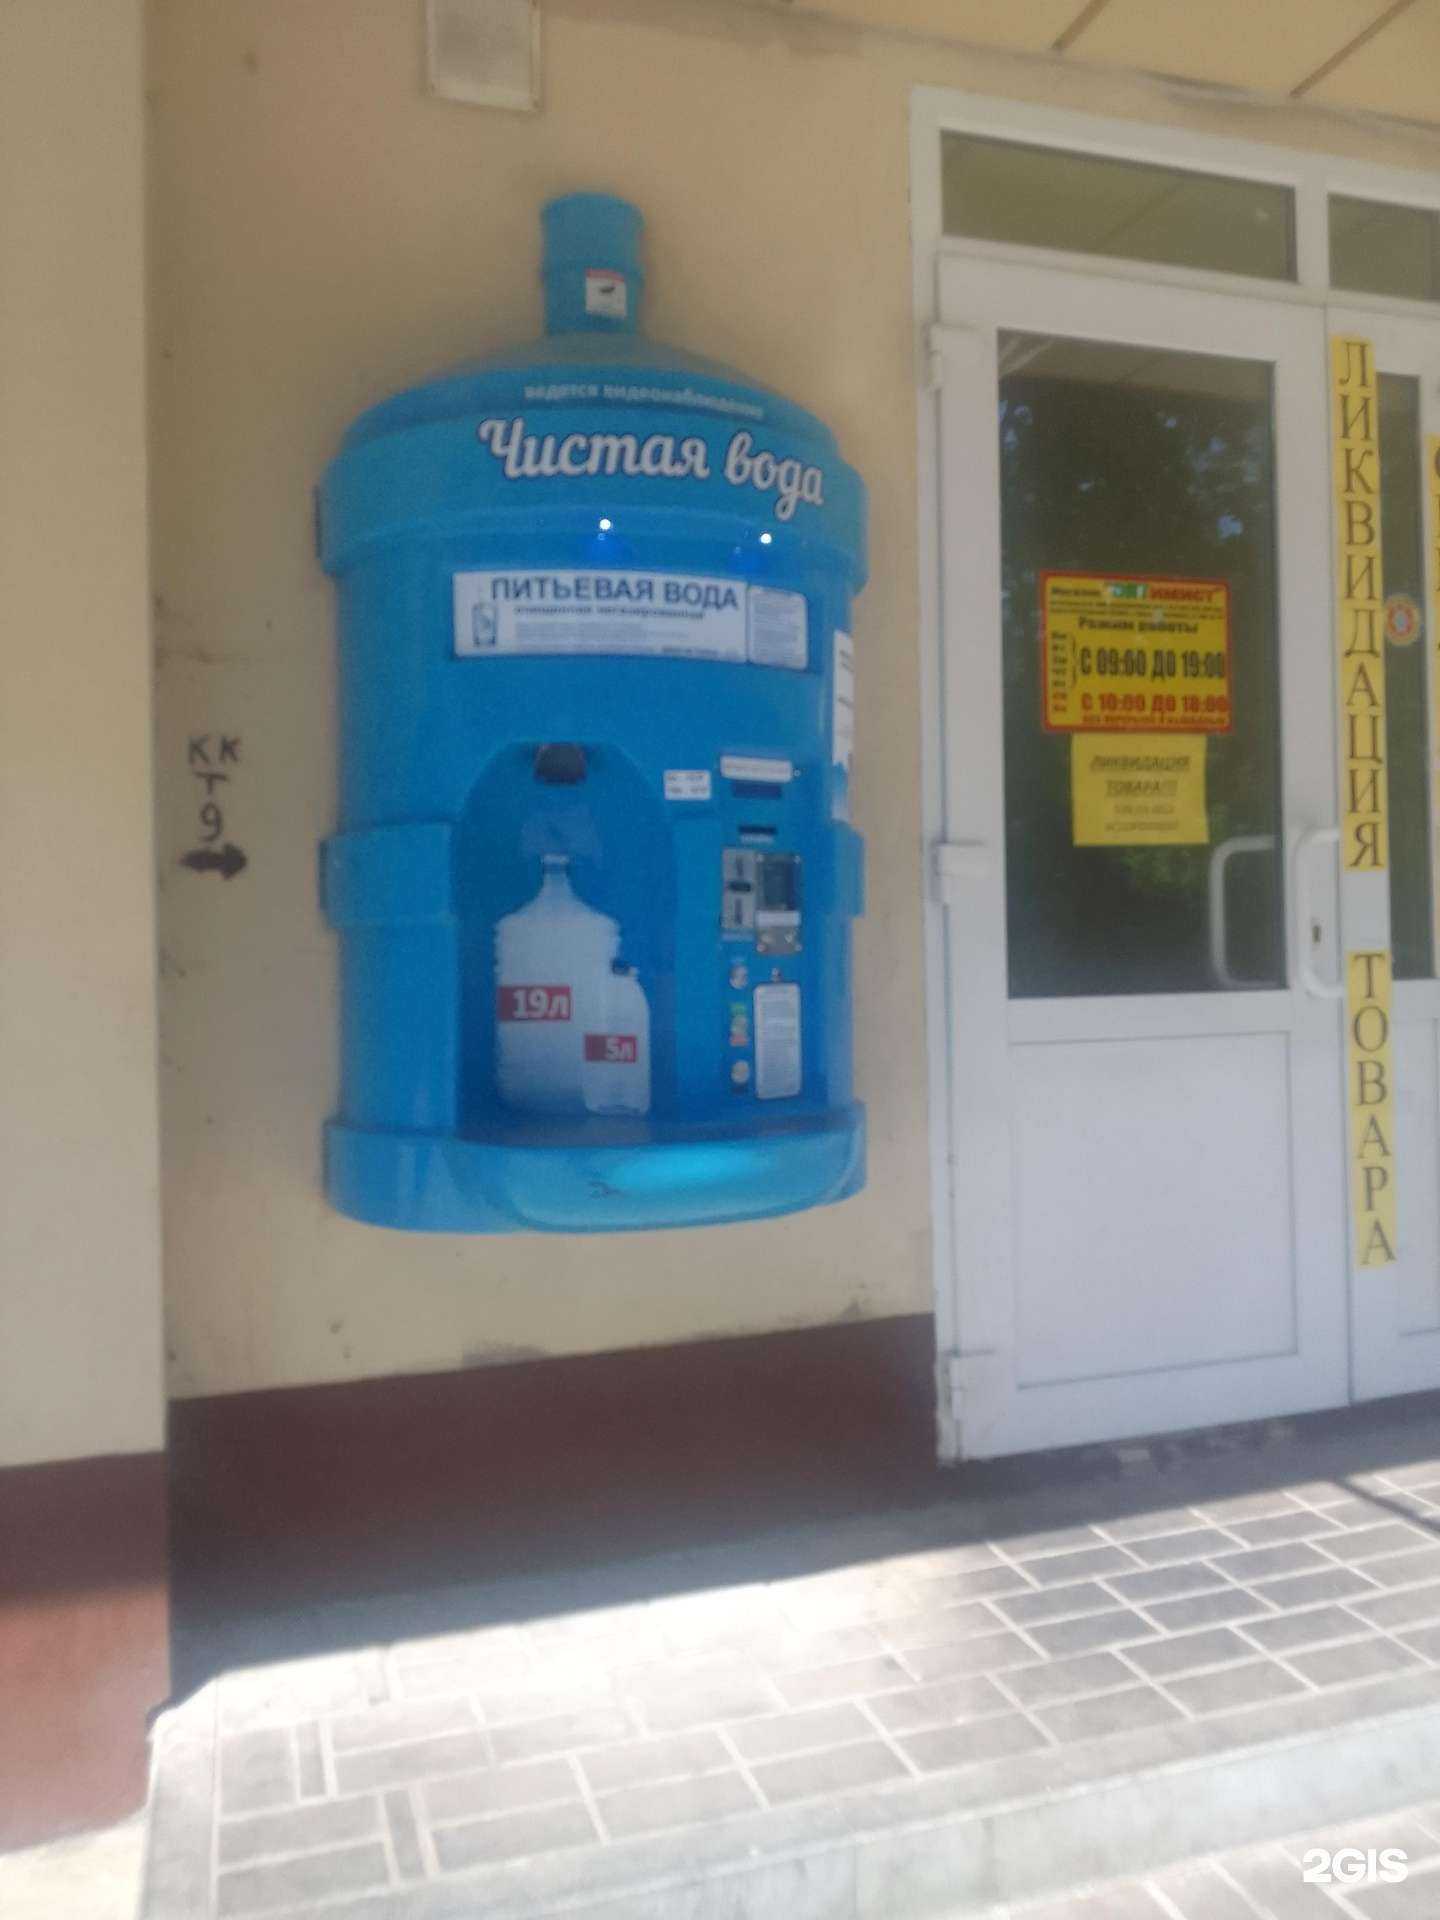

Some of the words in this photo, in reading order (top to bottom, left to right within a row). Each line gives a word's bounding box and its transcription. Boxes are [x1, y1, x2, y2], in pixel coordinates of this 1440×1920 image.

[476, 416, 711, 480] Чистая
[724, 429, 825, 522] вода
[491, 576, 655, 601] ПИТЬЕВАЯ
[663, 580, 740, 611] ВОДА
[1337, 340, 1385, 868] ЛИКВИДАЦИЯ
[1080, 647, 1092, 675] С
[1151, 650, 1177, 683] ДО
[200, 801, 224, 843] 9
[511, 987, 570, 1019] 19л
[1352, 952, 1398, 1267] ТОВАРА
